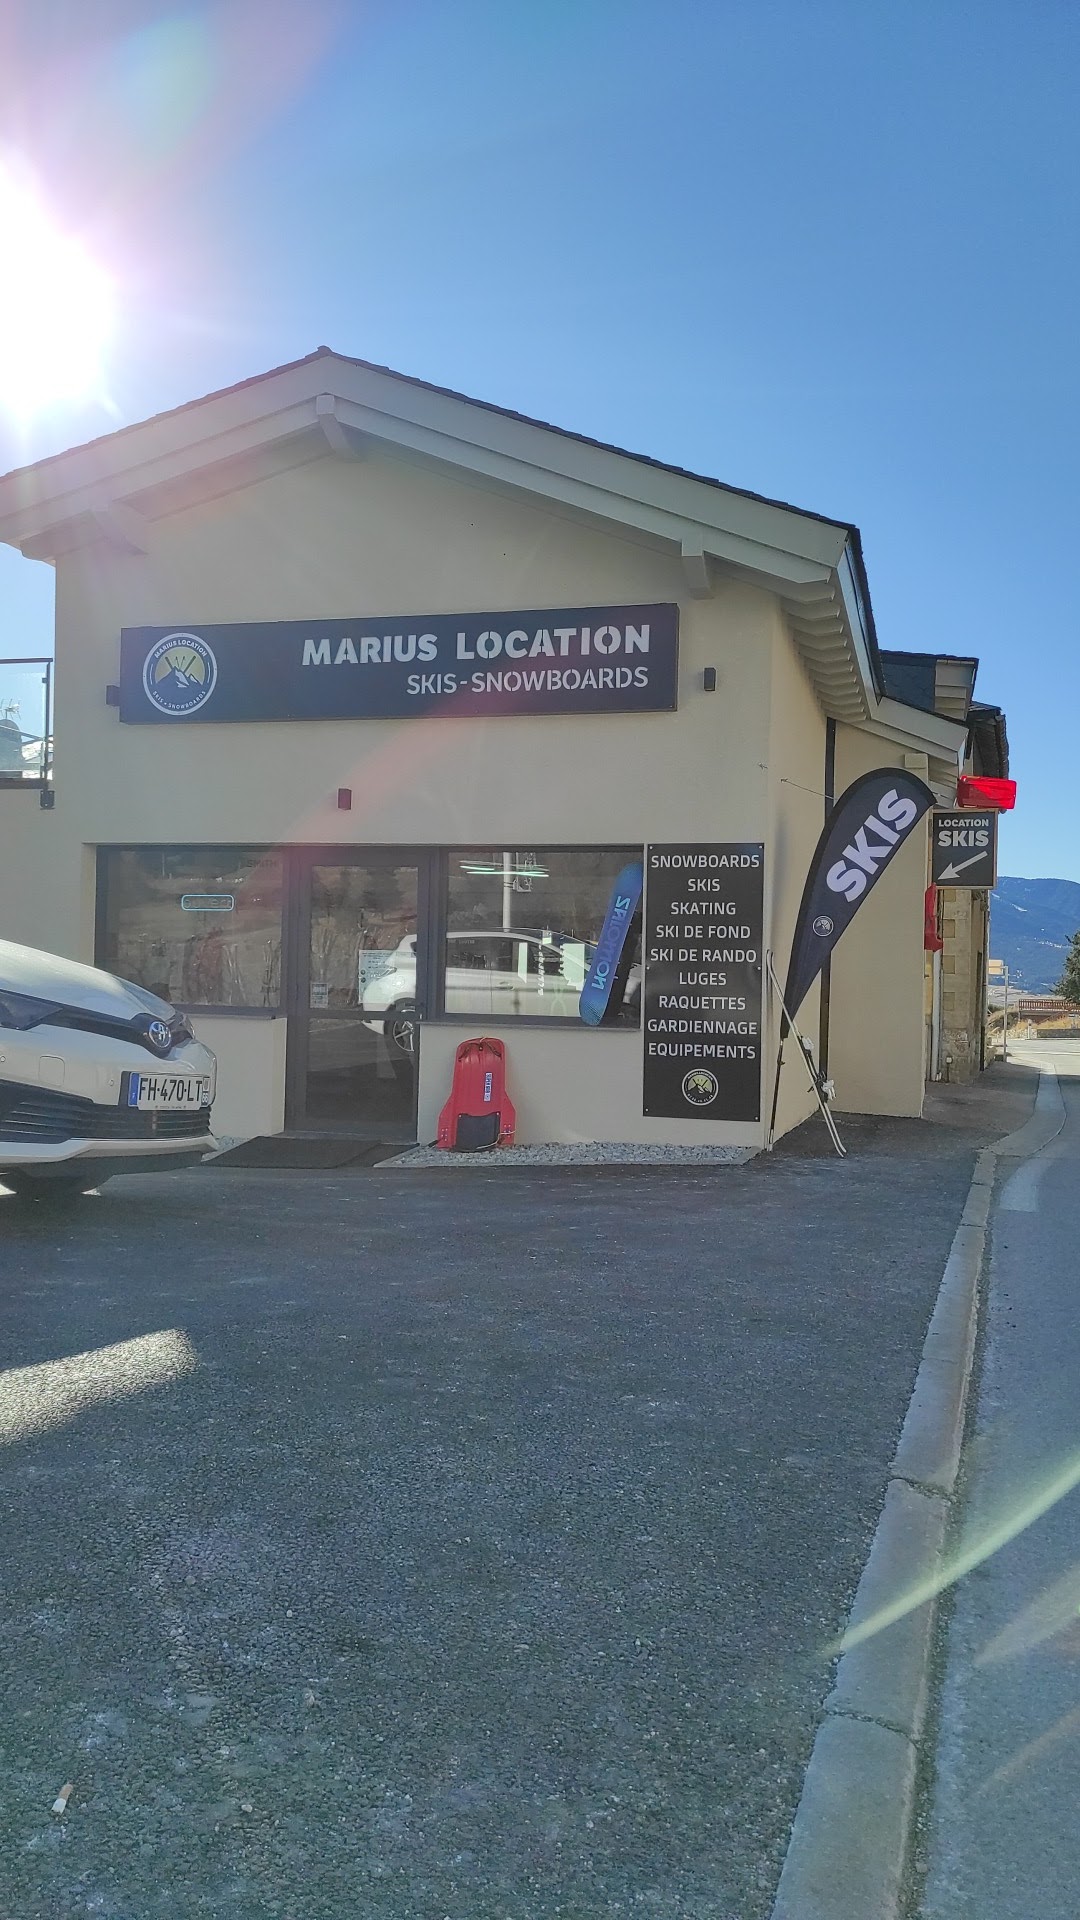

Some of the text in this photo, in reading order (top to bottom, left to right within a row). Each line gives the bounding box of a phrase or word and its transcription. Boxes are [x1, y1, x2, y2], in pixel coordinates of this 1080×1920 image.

[154, 639, 208, 658] MARIUS LOCATION
[302, 624, 650, 666] MARIUS LOCATION
[938, 818, 989, 828] LOCATION
[826, 788, 918, 903] SKIS
[937, 829, 990, 847] SKIS
[651, 854, 760, 868] SNOWBOARDS
[687, 878, 720, 892] SKIS
[670, 902, 736, 915] SKATING
[656, 925, 751, 939] SKI DE FOND
[591, 896, 631, 990] SALOMON
[650, 948, 757, 963] SKI DE RANDO
[679, 972, 727, 986] LUGES
[658, 995, 746, 1011] RAQUETTES
[647, 1019, 758, 1035] GARDIENNAGE
[648, 1042, 756, 1059] EQUIPEMENTS
[139, 1077, 202, 1101] FH-470-LT
